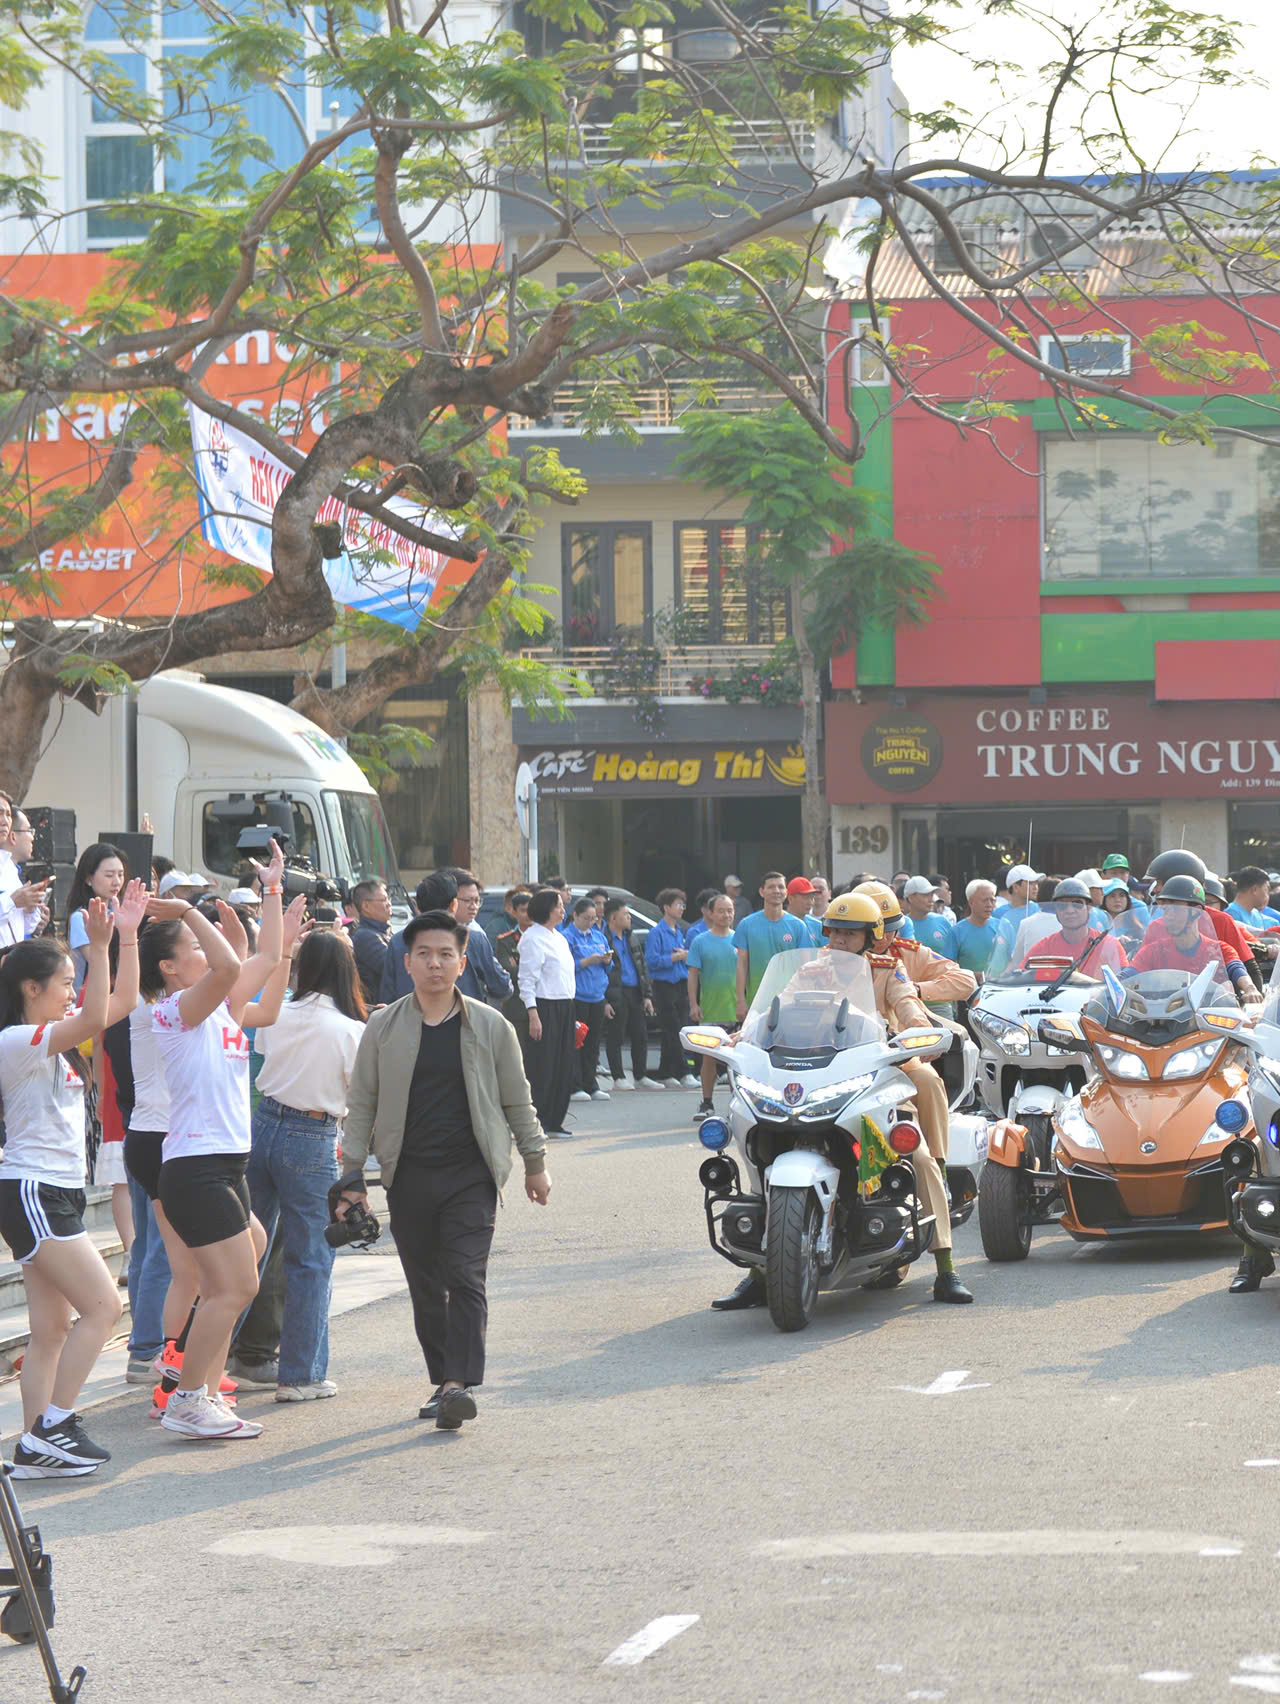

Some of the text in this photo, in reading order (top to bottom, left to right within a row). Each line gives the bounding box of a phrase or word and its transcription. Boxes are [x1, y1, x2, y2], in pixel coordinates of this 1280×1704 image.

[56, 548, 136, 571] ASSET
[976, 708, 1110, 732] COFFEE
[592, 751, 701, 786] Hoàng
[714, 748, 765, 779] Thi
[977, 742, 1142, 777] TRUNG
[1245, 778, 1261, 788] 139
[837, 824, 889, 854] 139
